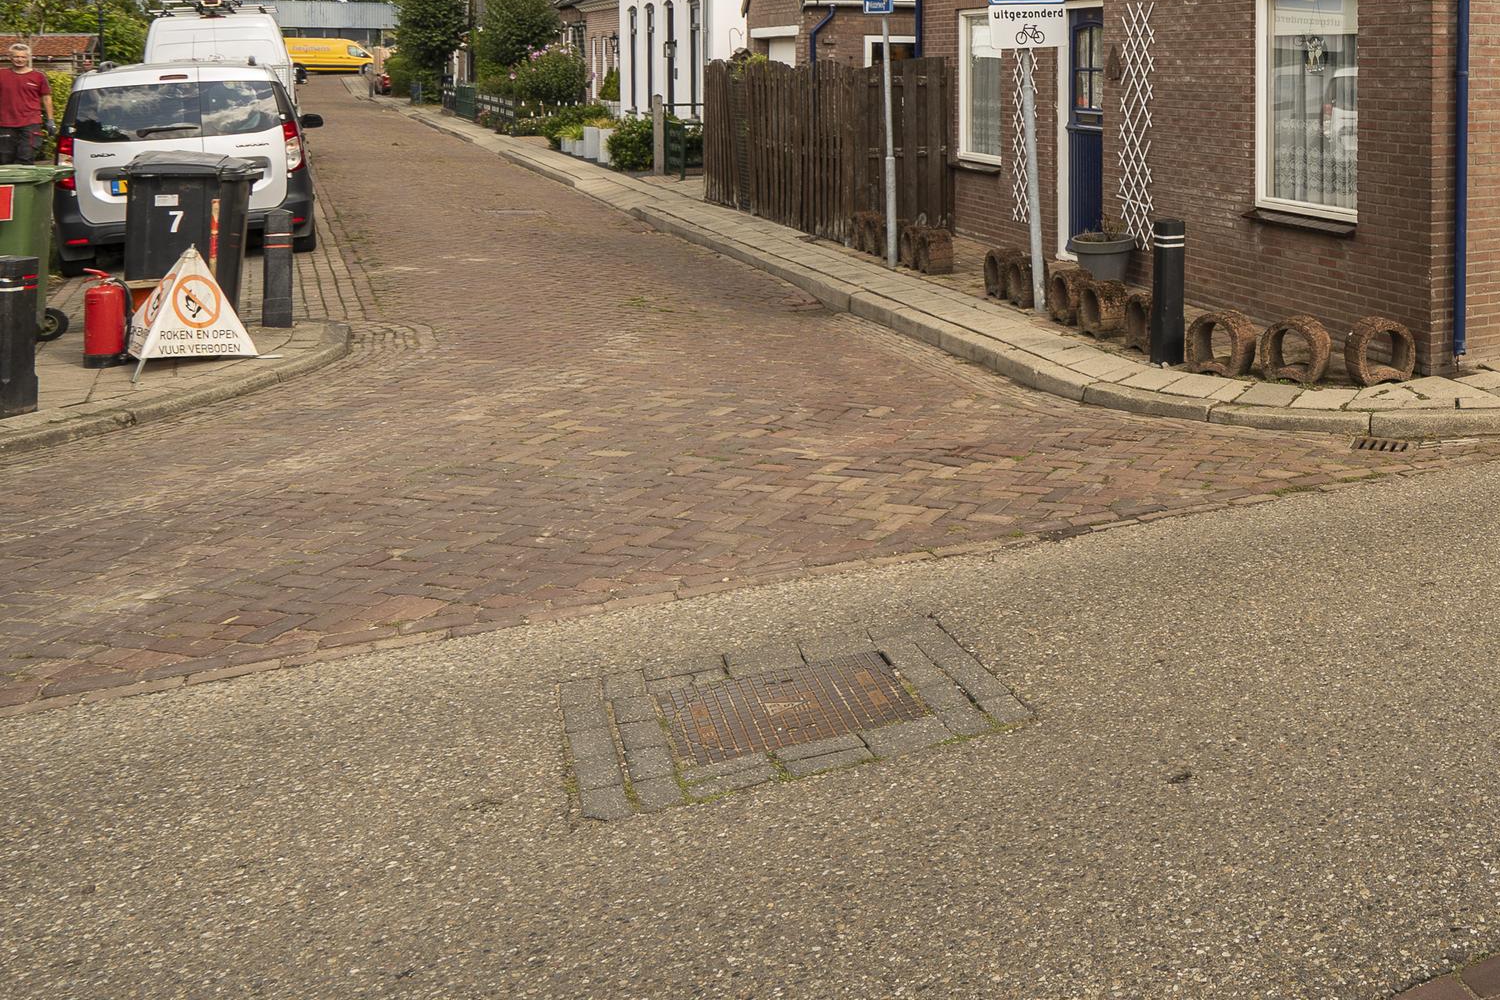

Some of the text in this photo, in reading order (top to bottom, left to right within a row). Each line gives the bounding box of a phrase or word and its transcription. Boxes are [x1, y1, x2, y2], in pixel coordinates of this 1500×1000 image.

[993, 8, 1064, 21] uitgezonderd
[168, 210, 184, 233] 7
[160, 330, 193, 340] ROKEN
[196, 329, 210, 340] EN
[212, 329, 239, 339] OPEN
[158, 343, 241, 355] VUUR VERBODEN
